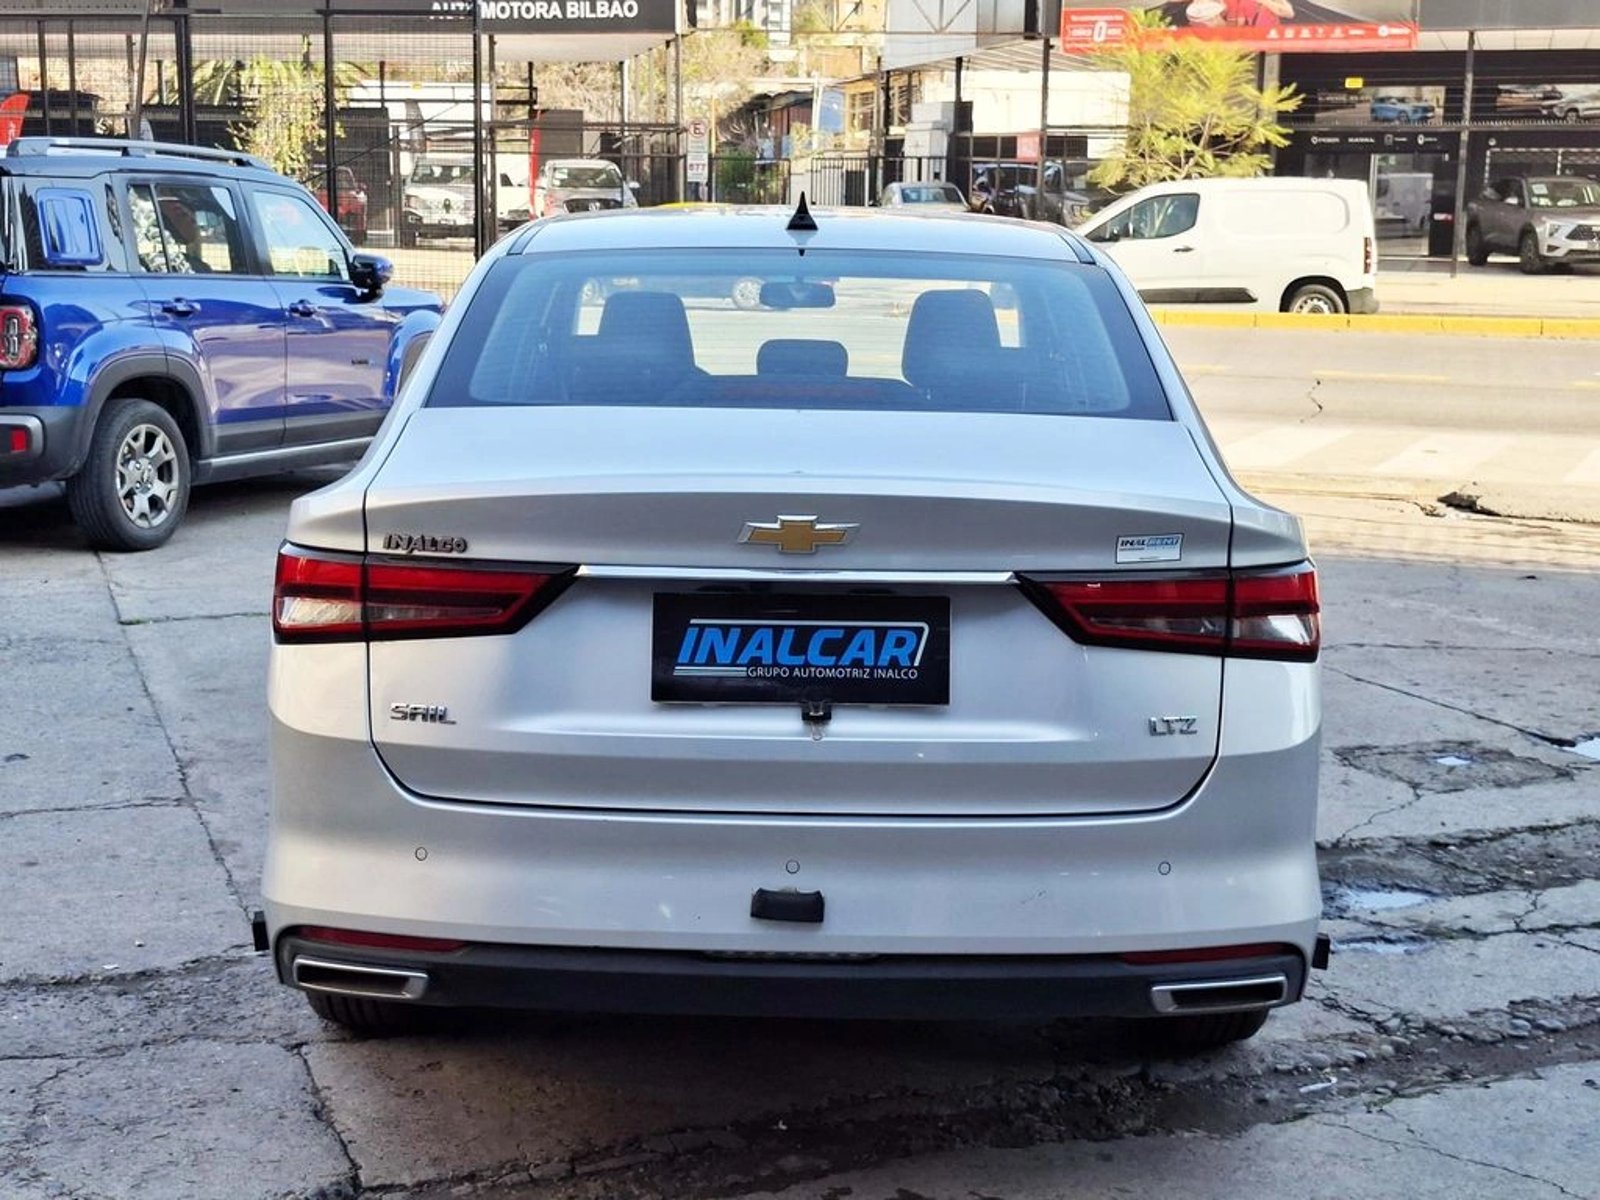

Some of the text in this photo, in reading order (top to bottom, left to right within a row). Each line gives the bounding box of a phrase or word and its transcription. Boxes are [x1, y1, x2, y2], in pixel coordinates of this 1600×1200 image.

[566, 1, 638, 18] BILBAO
[382, 534, 468, 553] INALCO
[677, 627, 918, 667] INALCAR
[747, 667, 918, 680] GRUPO AUTOMOTRIZ INALCO
[390, 703, 457, 725] SAIL
[1148, 716, 1198, 736] LTZ
